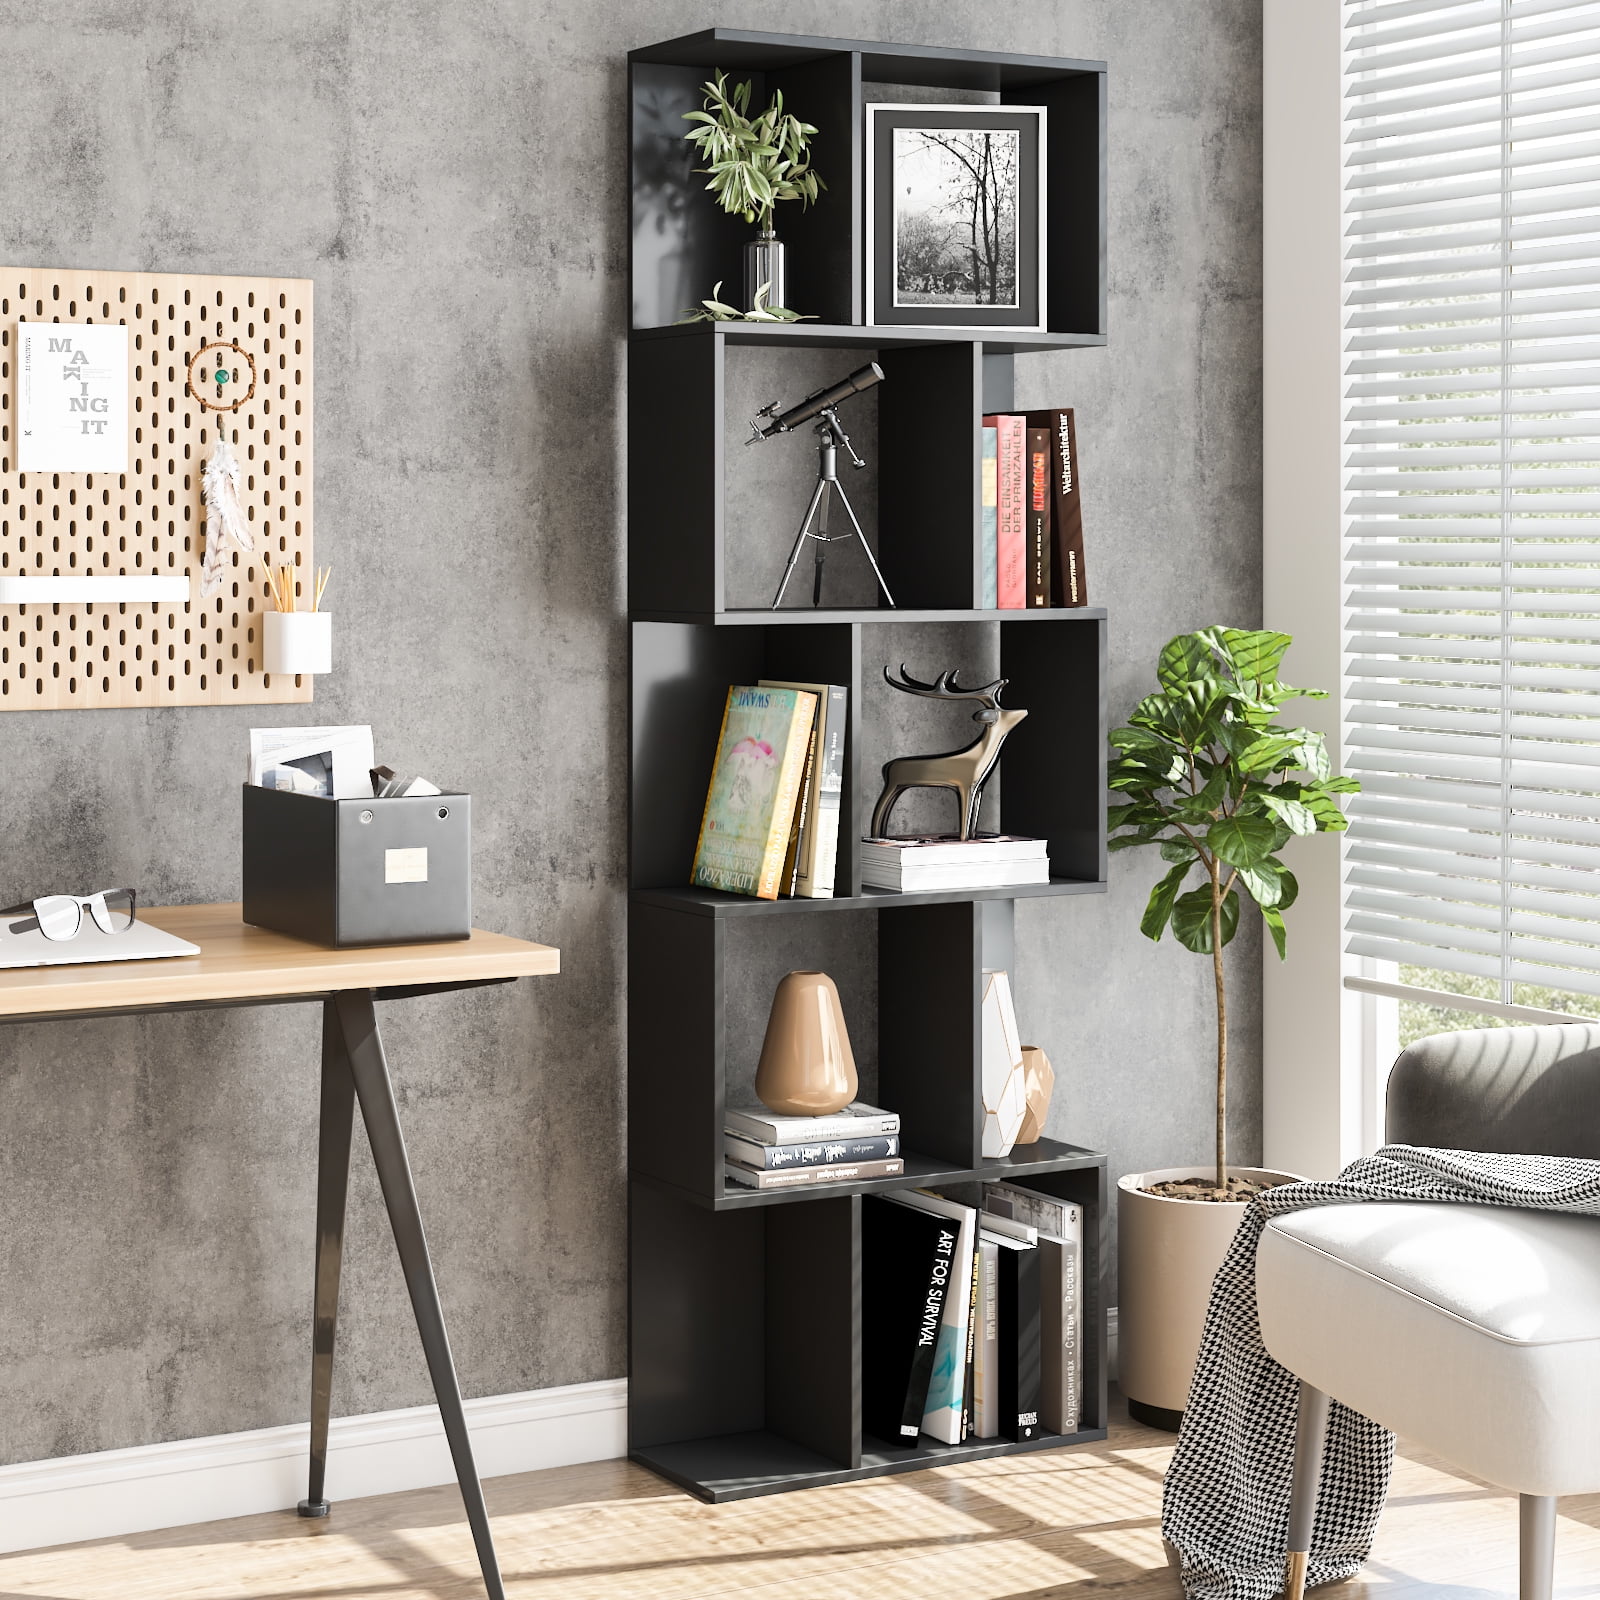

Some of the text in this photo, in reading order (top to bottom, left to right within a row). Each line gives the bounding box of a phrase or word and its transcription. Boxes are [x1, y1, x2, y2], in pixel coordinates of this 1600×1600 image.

[69, 398, 109, 412] NG
[81, 420, 108, 434] IT
[1002, 433, 1011, 533] DIE EINSAMKEIT
[1013, 420, 1021, 533] DER PRIMZAHLEN
[1059, 413, 1073, 495] Weltarchitektur
[1068, 550, 1078, 603] westermann
[738, 691, 771, 708] SWAMI
[700, 866, 755, 890] LIDERAZGO
[918, 1230, 955, 1347] ART FOR SURVIVAL
[1064, 1255, 1078, 1427] О художниках Статьи Рассказы
